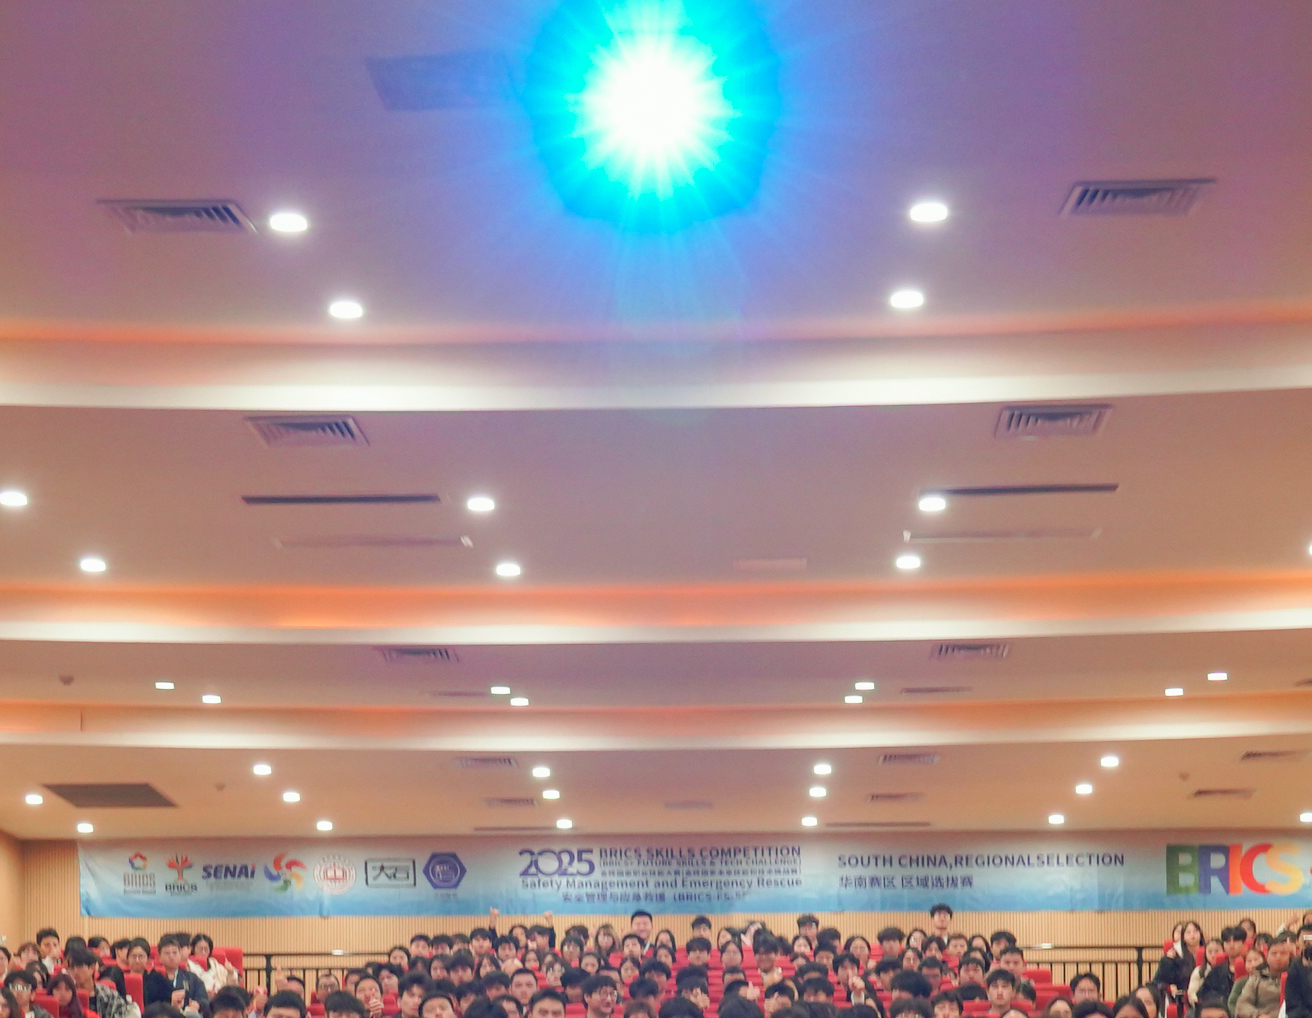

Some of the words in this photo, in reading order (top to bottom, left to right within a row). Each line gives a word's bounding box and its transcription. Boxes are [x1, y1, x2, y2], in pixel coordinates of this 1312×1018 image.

[599, 847, 642, 860] BRICS
[646, 847, 695, 860] SKILLS
[699, 845, 801, 859] COMPETITION
[518, 848, 596, 876] 2025
[838, 854, 893, 868] SOUTH
[521, 879, 562, 892] Safety
[566, 879, 649, 892] Management
[654, 877, 678, 889] and
[681, 877, 753, 891] Emergency
[757, 877, 803, 888] Rescue
